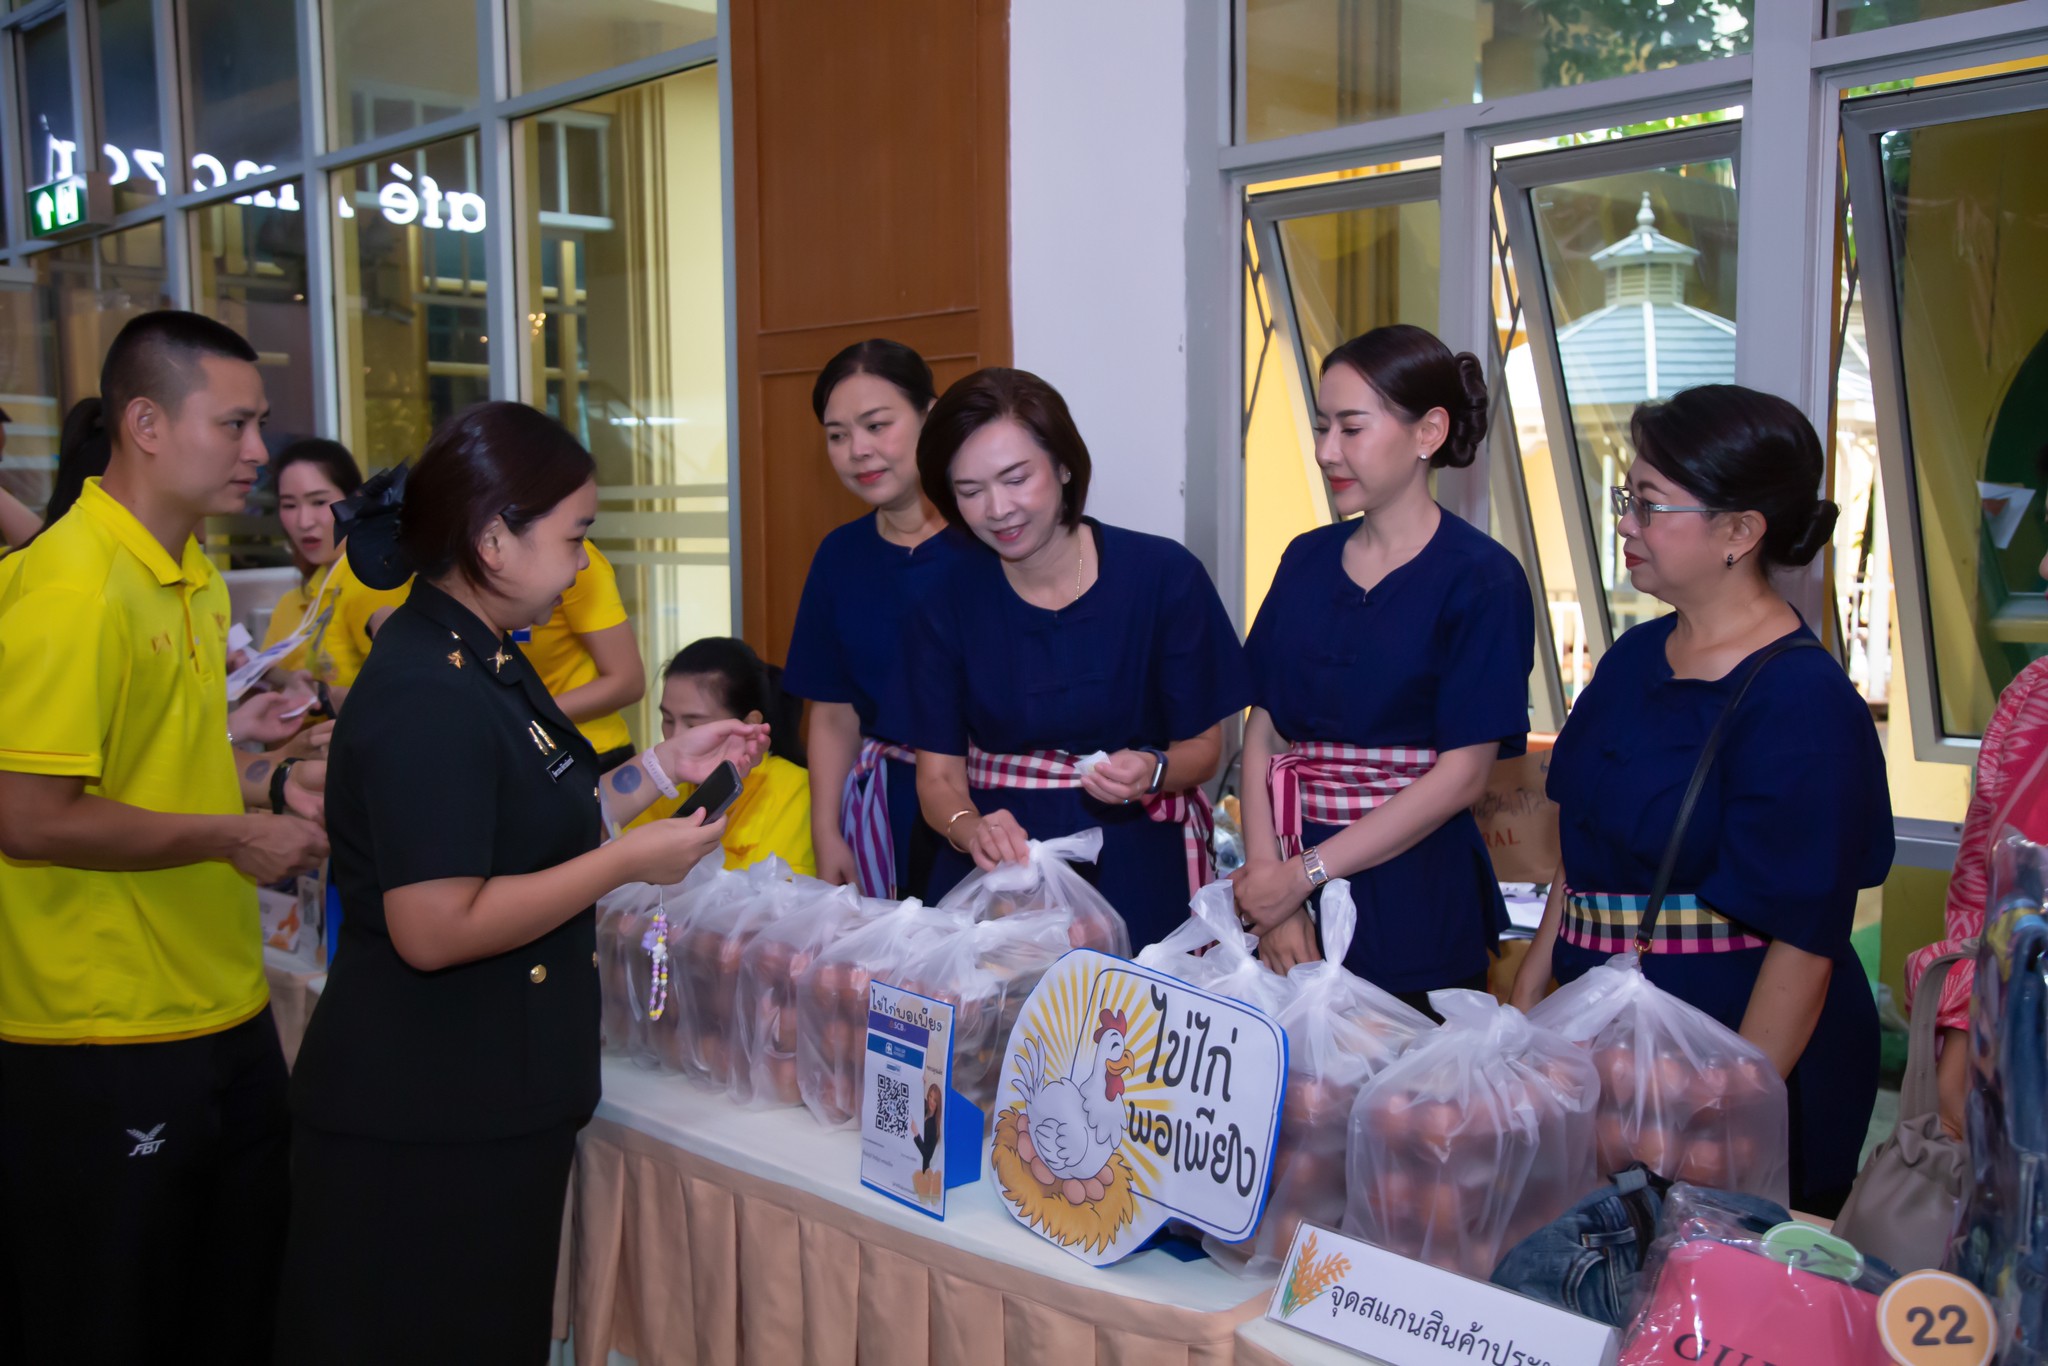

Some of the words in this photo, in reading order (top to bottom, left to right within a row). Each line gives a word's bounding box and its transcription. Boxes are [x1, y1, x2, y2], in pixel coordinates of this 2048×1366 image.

[1146, 983, 1239, 1103] ไข่ไก่
[128, 1138, 167, 1157] FBT
[1128, 1100, 1257, 1198] พอเพียง
[1330, 1284, 1551, 1366] จุดสแกนสินค้าประ
[1673, 1333, 1779, 1366] GU
[1906, 1304, 1975, 1347] 22
